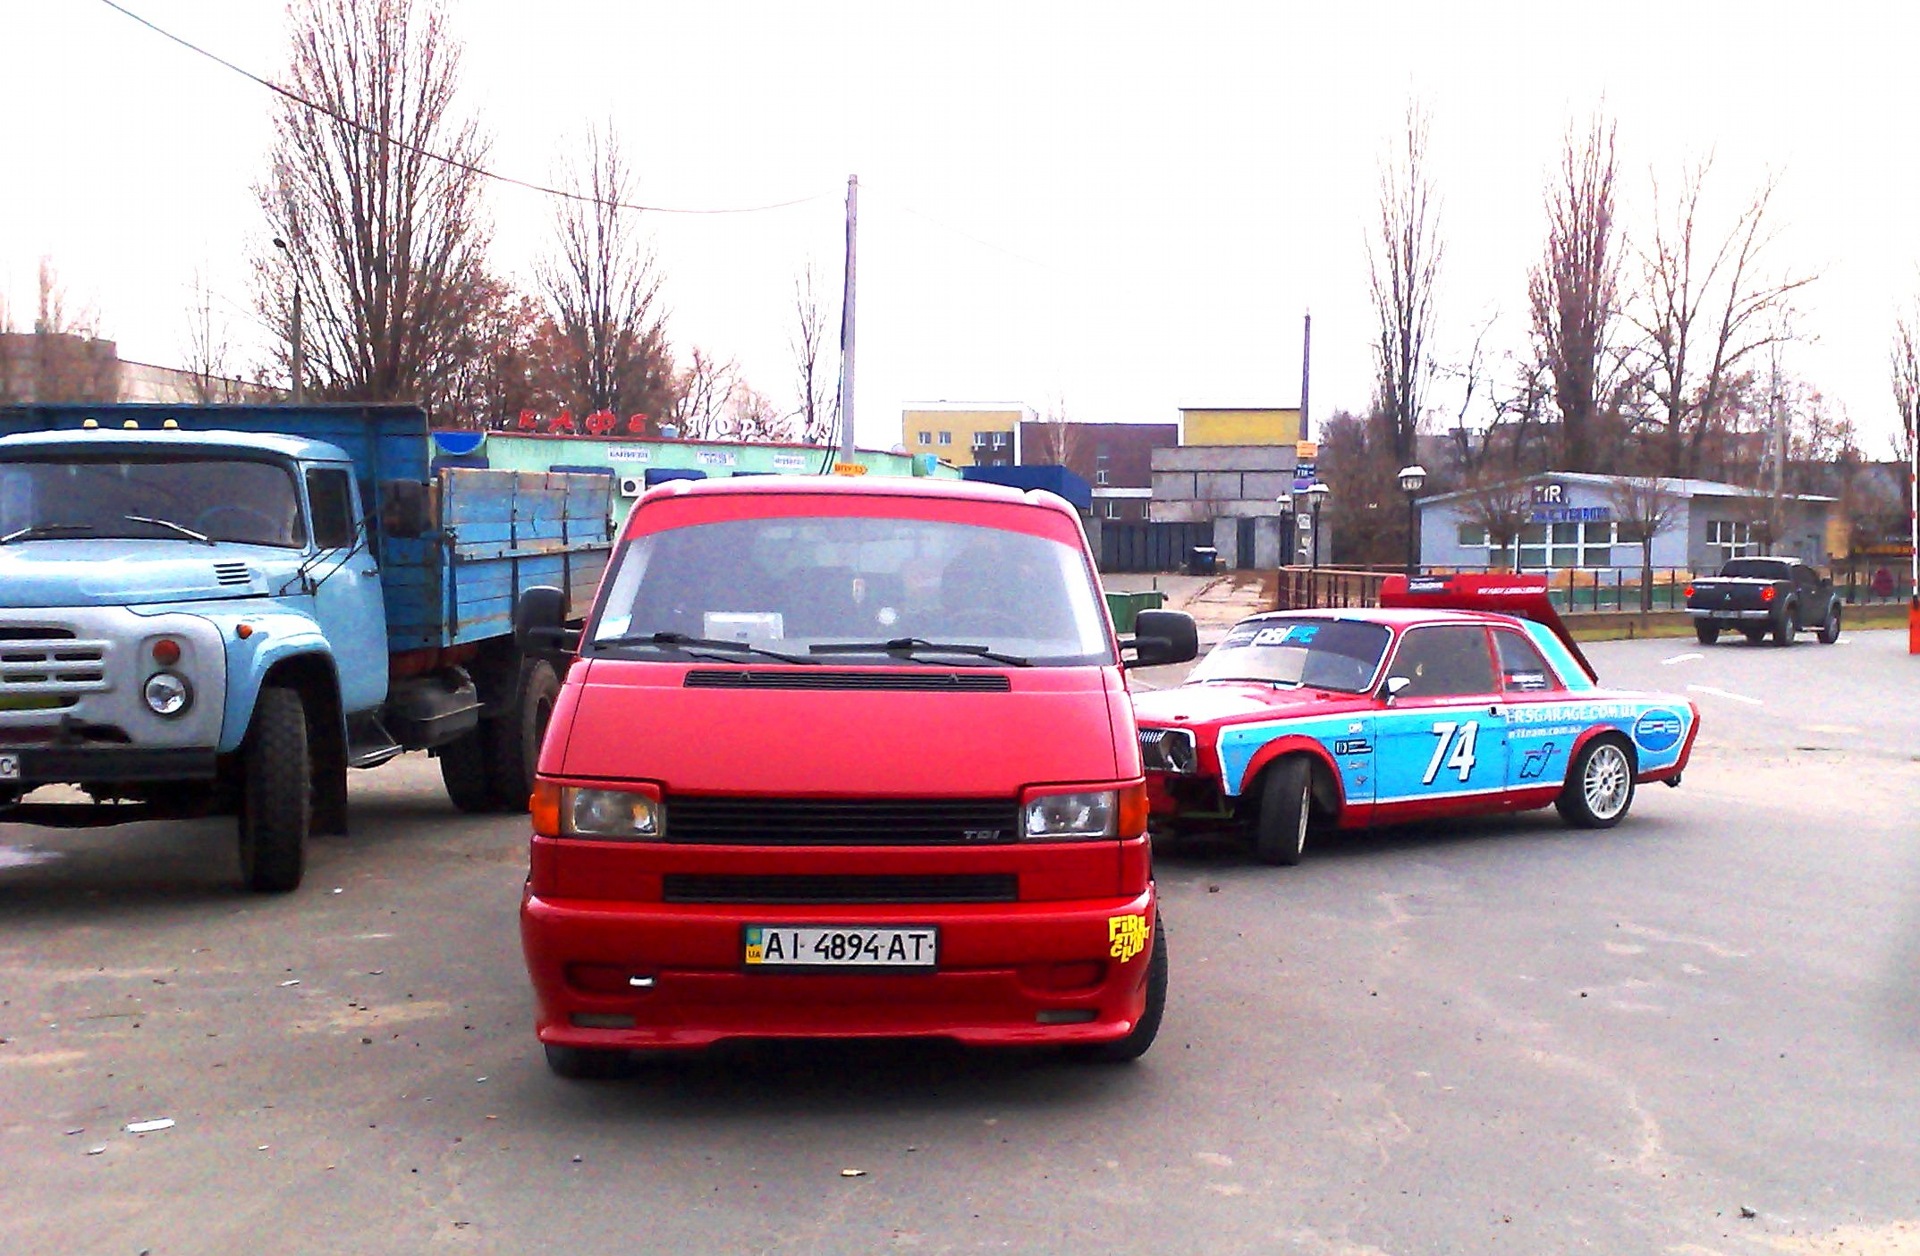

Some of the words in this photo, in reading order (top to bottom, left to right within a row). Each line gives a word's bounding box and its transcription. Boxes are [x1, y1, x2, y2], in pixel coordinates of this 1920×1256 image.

[518, 408, 648, 436] КАФЕ
[1422, 720, 1479, 785] 74
[748, 950, 761, 959] UA
[764, 932, 799, 960] AI
[814, 933, 879, 960] 4894
[887, 933, 928, 960] AT
